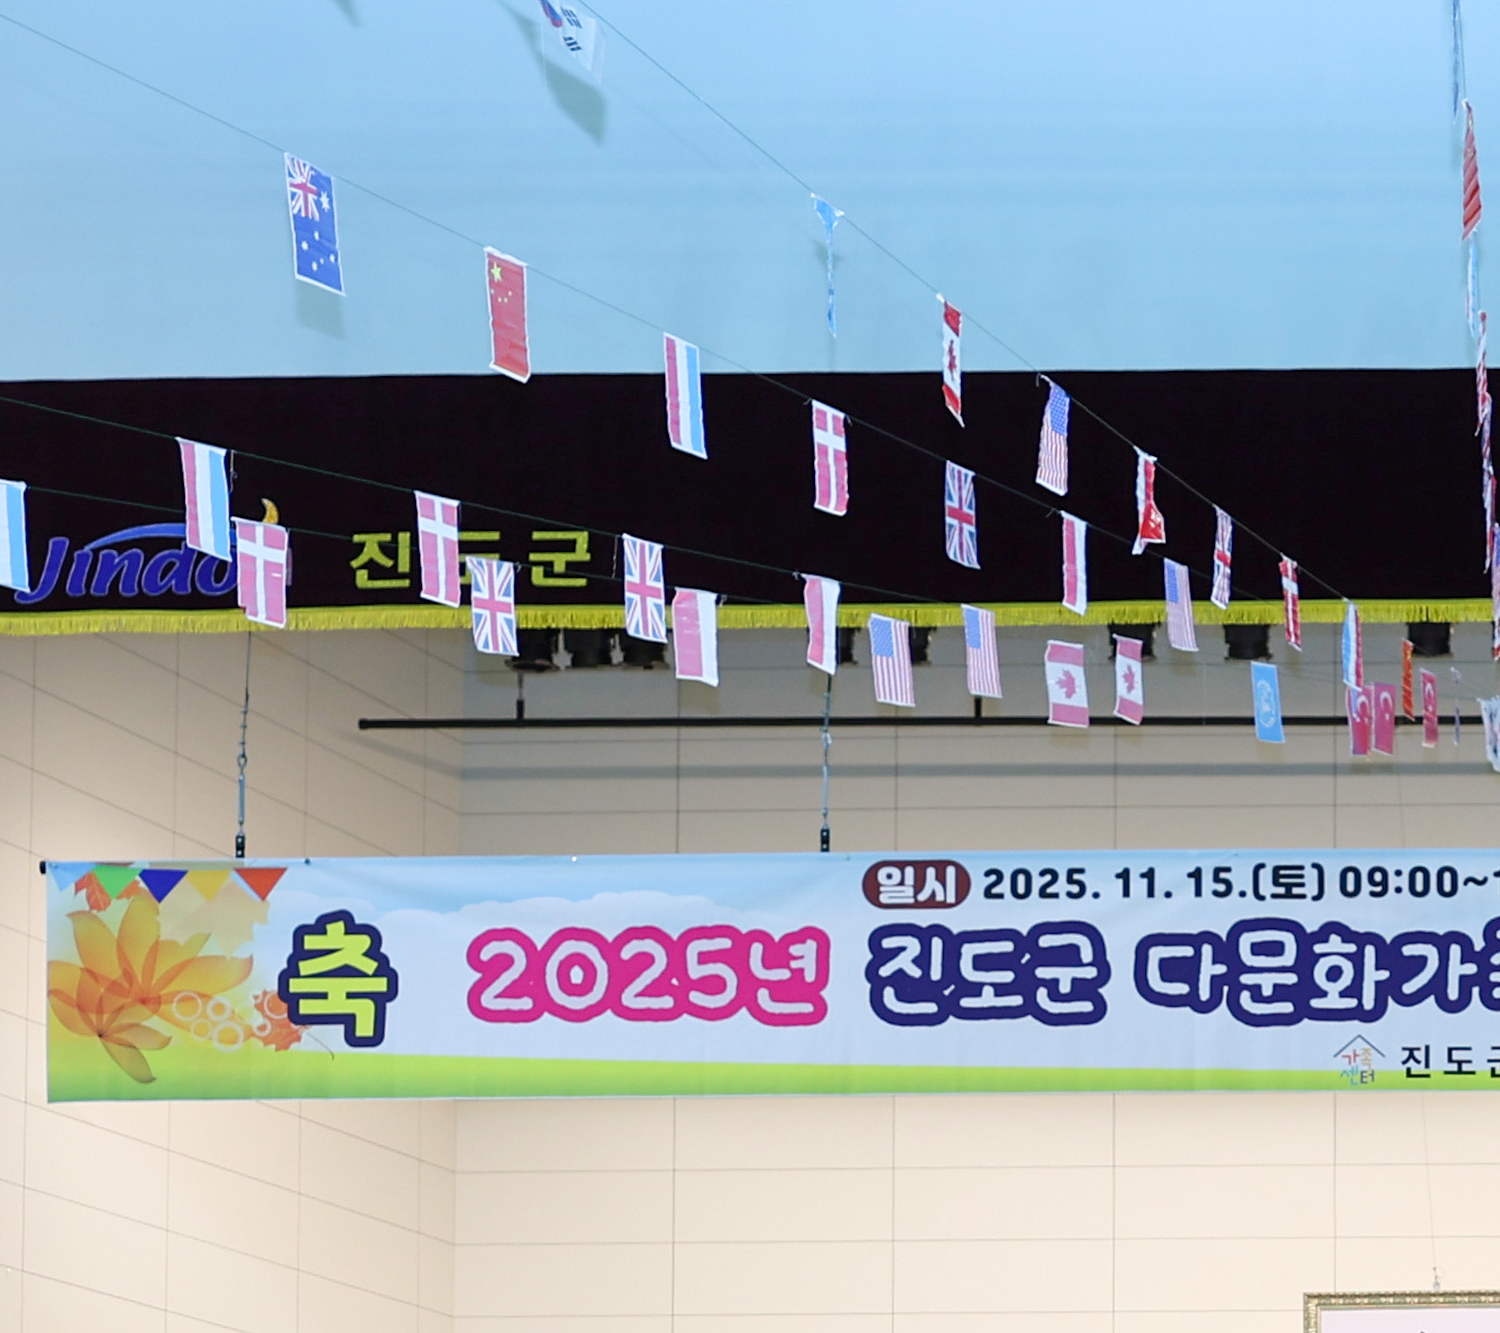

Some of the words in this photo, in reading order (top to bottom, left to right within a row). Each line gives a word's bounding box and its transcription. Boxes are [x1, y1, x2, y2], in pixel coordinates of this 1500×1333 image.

[14, 536, 238, 604] Jindo
[875, 864, 959, 905] 일시
[982, 867, 1106, 902] 2025.
[1117, 867, 1171, 901] 11.
[280, 912, 398, 1046] 축
[467, 925, 830, 1026] 2025년
[864, 918, 1110, 1026] 진도군
